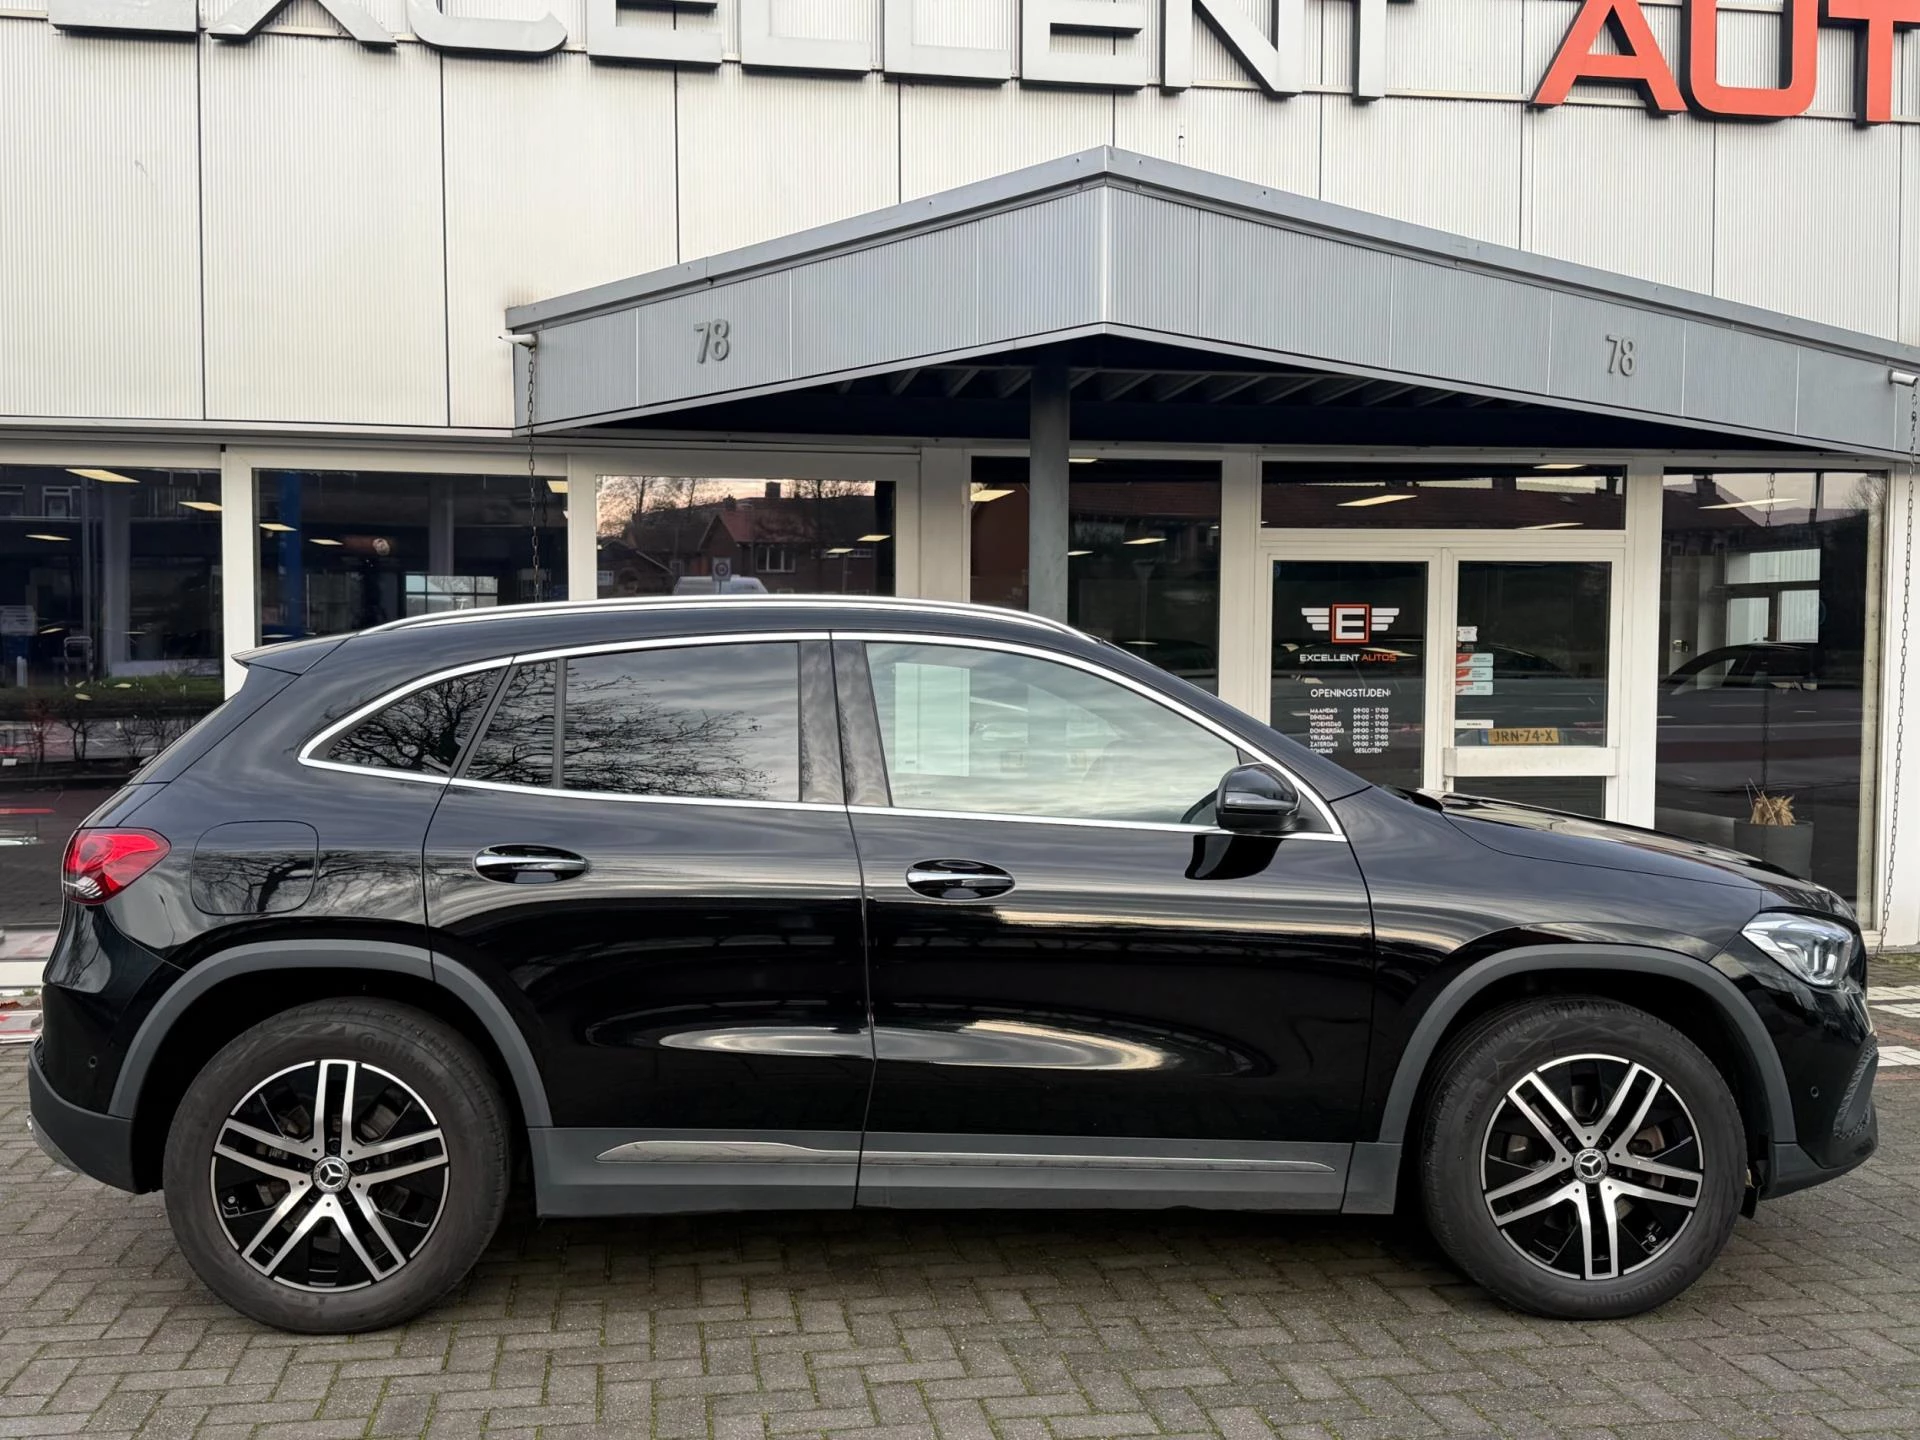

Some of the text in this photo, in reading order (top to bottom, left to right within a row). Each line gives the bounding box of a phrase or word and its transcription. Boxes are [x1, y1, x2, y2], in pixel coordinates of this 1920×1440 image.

[693, 319, 729, 364] 78
[1604, 334, 1637, 378] 78
[1335, 607, 1366, 640] E
[1299, 653, 1397, 662] EXCELLENT AUTOS
[1493, 729, 1553, 742] JRN-74-X
